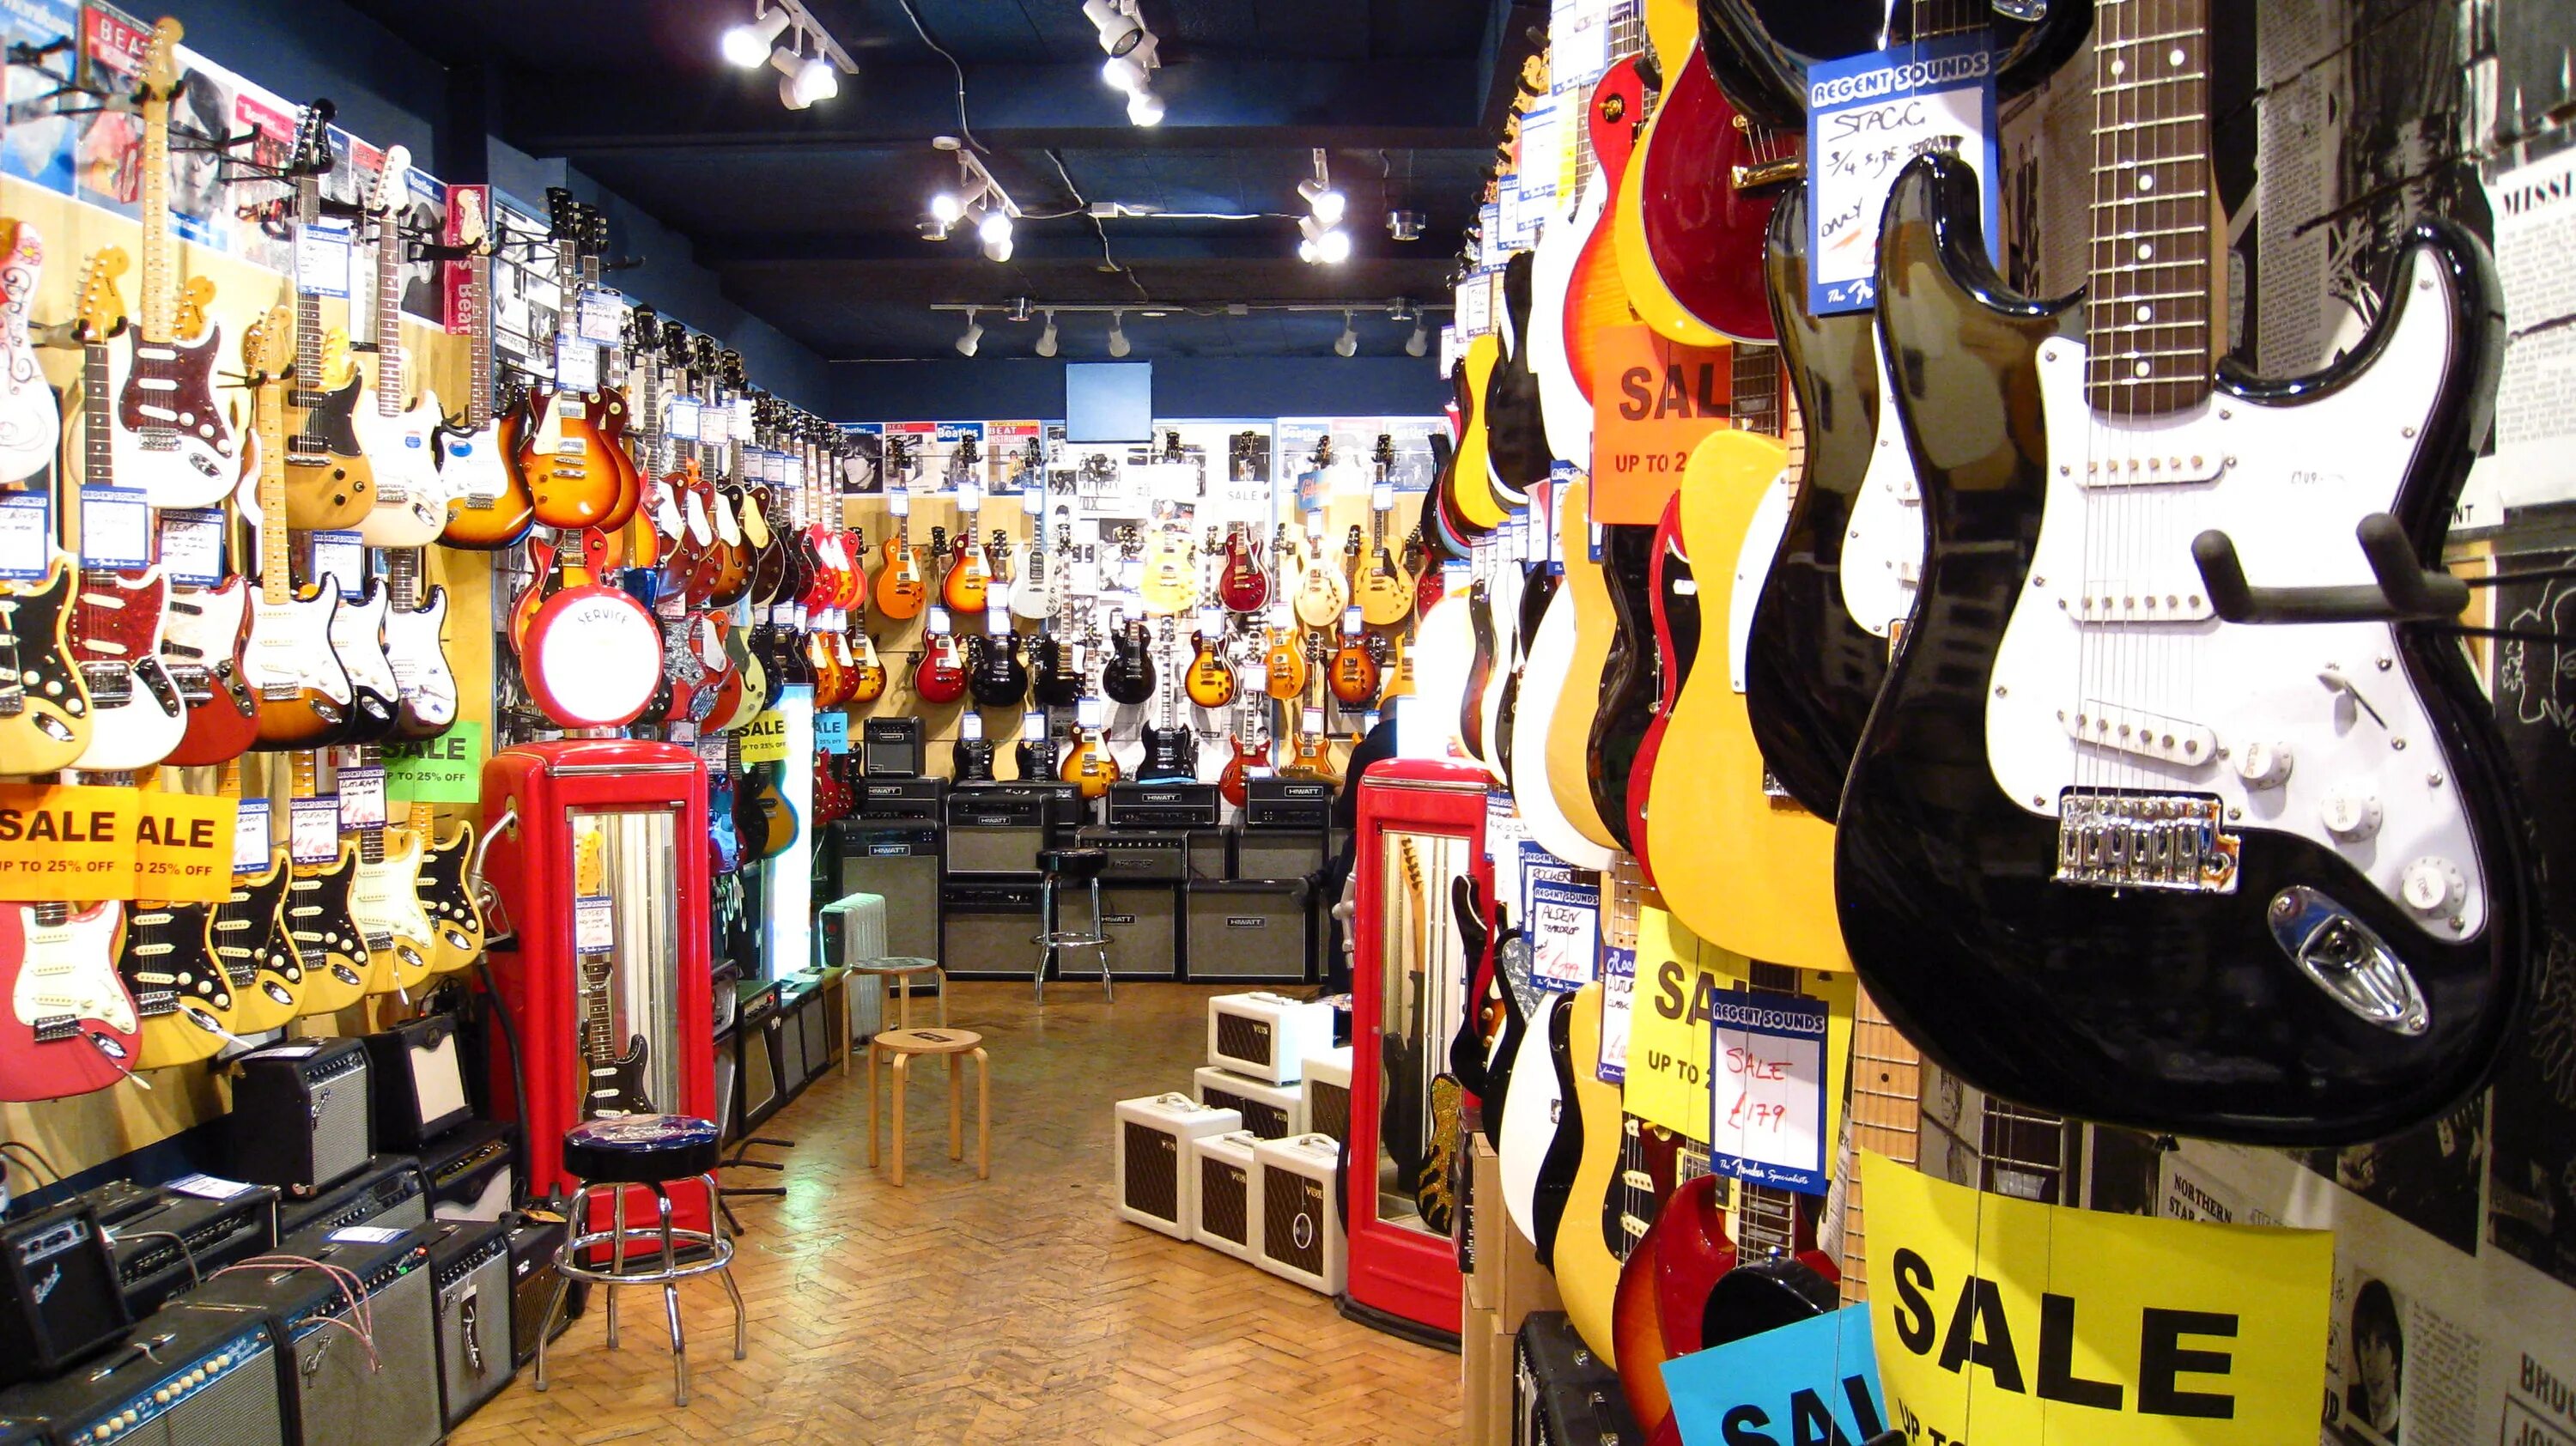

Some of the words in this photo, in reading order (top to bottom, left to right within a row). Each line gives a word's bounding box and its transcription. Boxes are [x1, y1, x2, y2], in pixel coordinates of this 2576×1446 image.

[1812, 68, 1893, 108] REGENT
[1894, 52, 1990, 91] SOUNDS
[1827, 289, 1845, 303] The
[1619, 362, 1731, 421] SAL
[937, 427, 978, 439] Beatles
[988, 434, 1038, 444] INSTRUMEN
[1615, 454, 1639, 472] UP
[1646, 453, 1668, 472] TO
[1228, 490, 1257, 501] SALE
[2452, 503, 2474, 525] NT
[577, 609, 629, 625] SERVICE
[739, 720, 785, 737] SALE
[816, 721, 841, 733] ALE
[398, 773, 413, 781] TO
[416, 772, 441, 782] 25%
[445, 773, 466, 781] OFF
[0, 809, 115, 841] SALE
[137, 816, 215, 848] ALE
[21, 861, 42, 872] TO
[47, 860, 82, 872] 25%
[87, 860, 114, 872] OFF
[1525, 852, 1554, 865] REGENT
[149, 862, 179, 874] 25%
[185, 865, 213, 876] OFF
[1534, 887, 1563, 900] REGENT
[1564, 890, 1599, 905] SOUNDS
[1541, 906, 1582, 923] ALDEN
[1713, 1002, 1761, 1026] REGENT
[1763, 1010, 1826, 1033] SOUNDS
[1253, 1024, 1268, 1035] VOX
[1648, 1049, 1671, 1072] UP
[1677, 1055, 1698, 1084] TO
[1727, 1047, 1794, 1080] SALE
[1728, 1091, 1785, 1133] £179
[1720, 1159, 1731, 1170] The
[1731, 1158, 1765, 1178] Fender
[1768, 1169, 1809, 1185] Specialists
[1305, 1185, 1323, 1199] VOX
[2174, 1173, 2233, 1224] NORTHERN
[463, 1305, 479, 1369] Fender
[1893, 1247, 2239, 1419] SALE
[1722, 1374, 1884, 1446] SAL
[1898, 1397, 1920, 1443] UP
